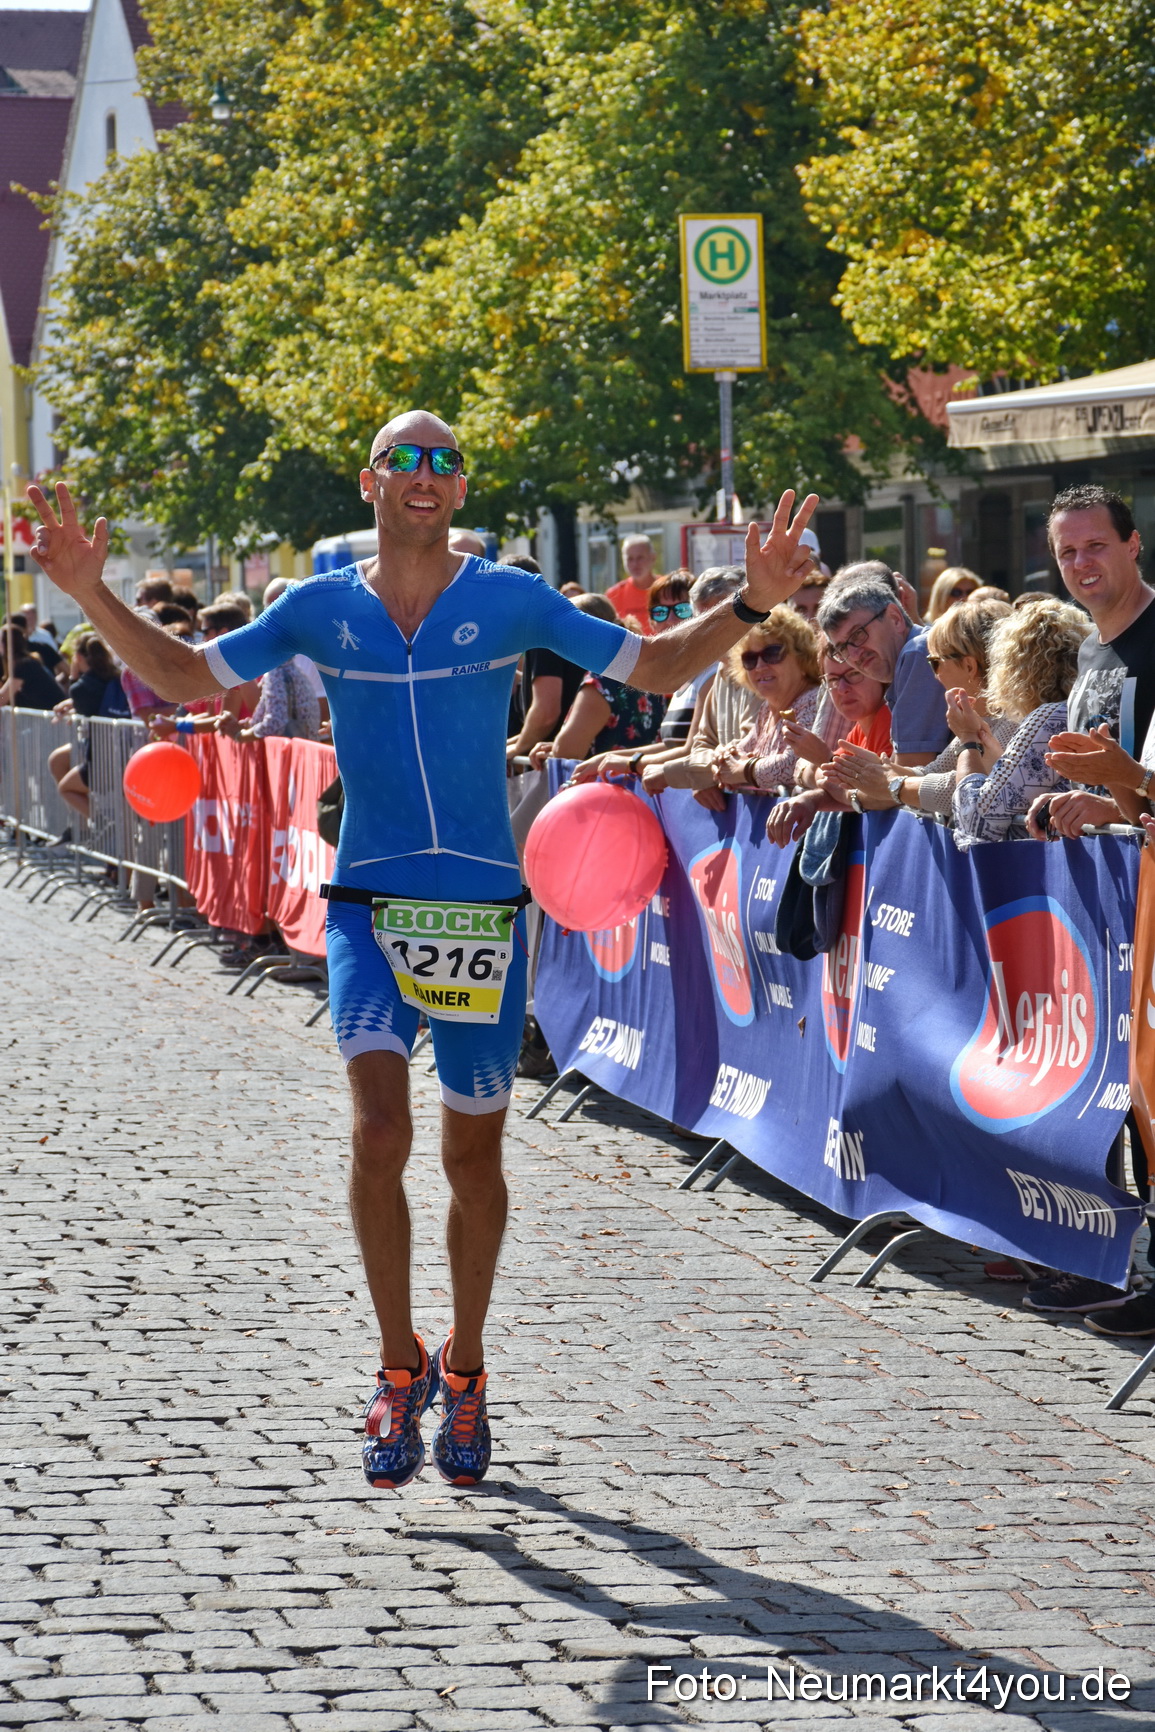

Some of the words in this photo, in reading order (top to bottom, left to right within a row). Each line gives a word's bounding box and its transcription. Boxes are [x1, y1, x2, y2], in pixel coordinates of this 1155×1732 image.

[709, 240, 736, 271] H
[699, 291, 748, 302] Marktplatz
[451, 662, 491, 676] RAINER
[385, 906, 502, 937] BOCK
[871, 903, 915, 937] STORE
[391, 940, 496, 980] 1216
[413, 983, 470, 1007] RAINER
[768, 982, 793, 1009] MOBILE
[579, 1016, 616, 1055] GET
[857, 1021, 877, 1053] MOBILE
[709, 1063, 739, 1111] GET
[969, 1063, 1030, 1092] SPORTS
[1006, 1168, 1052, 1222] GET
